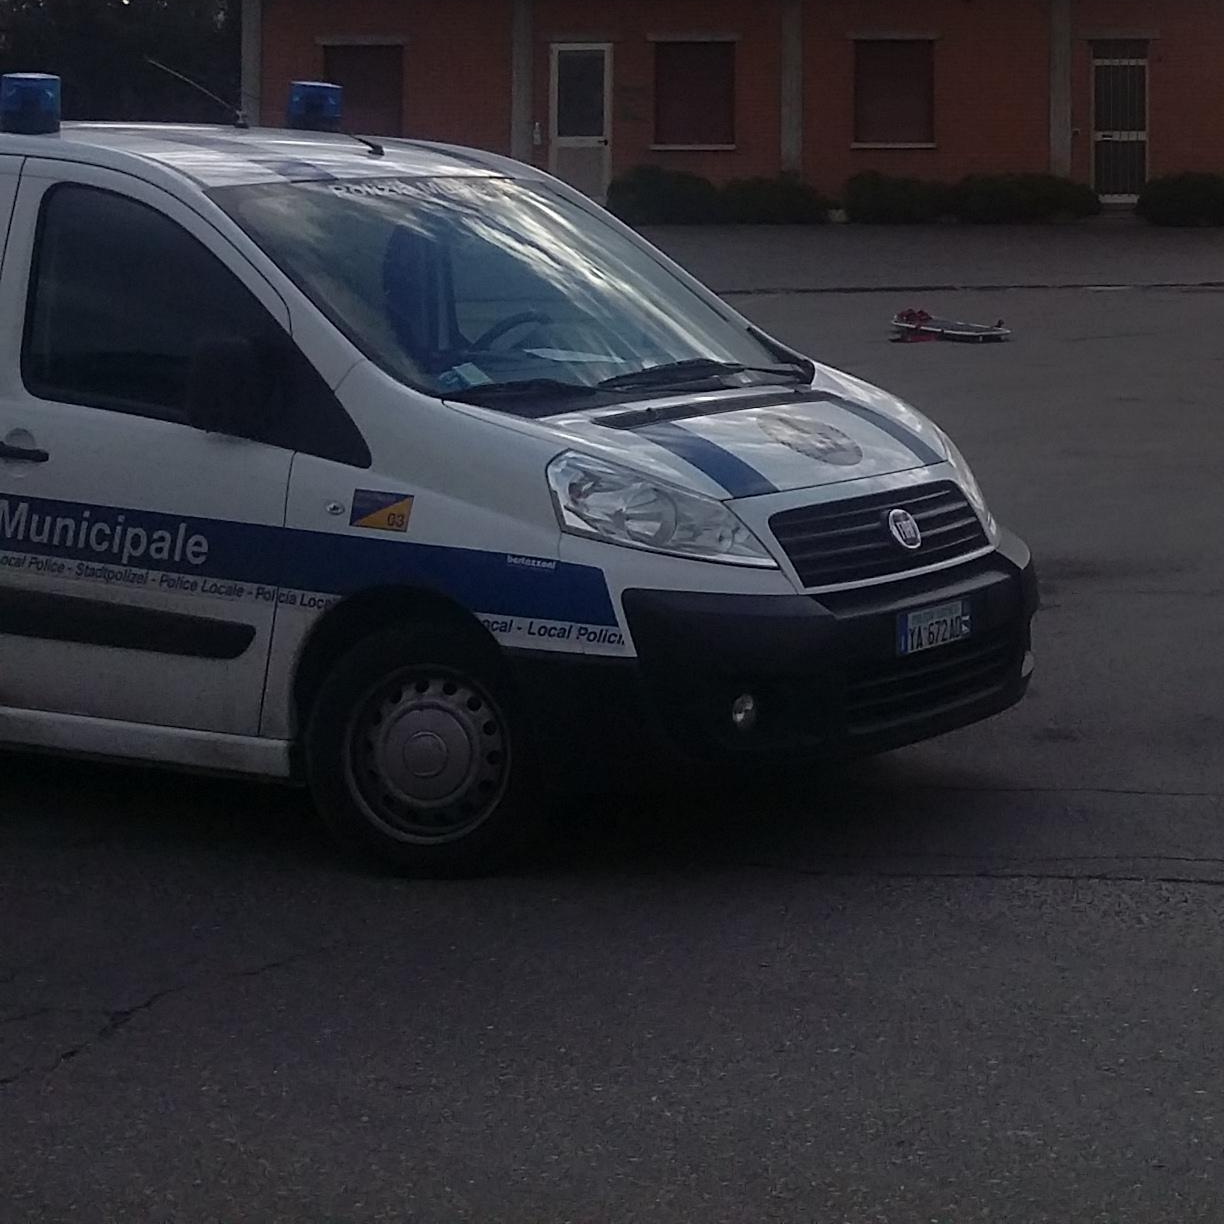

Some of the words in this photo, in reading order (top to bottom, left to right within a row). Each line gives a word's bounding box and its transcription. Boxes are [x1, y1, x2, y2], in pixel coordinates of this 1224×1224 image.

[0, 499, 209, 565] Municipale
[0, 555, 25, 569] ocal
[527, 621, 573, 640] Local
[928, 618, 948, 646] 672
